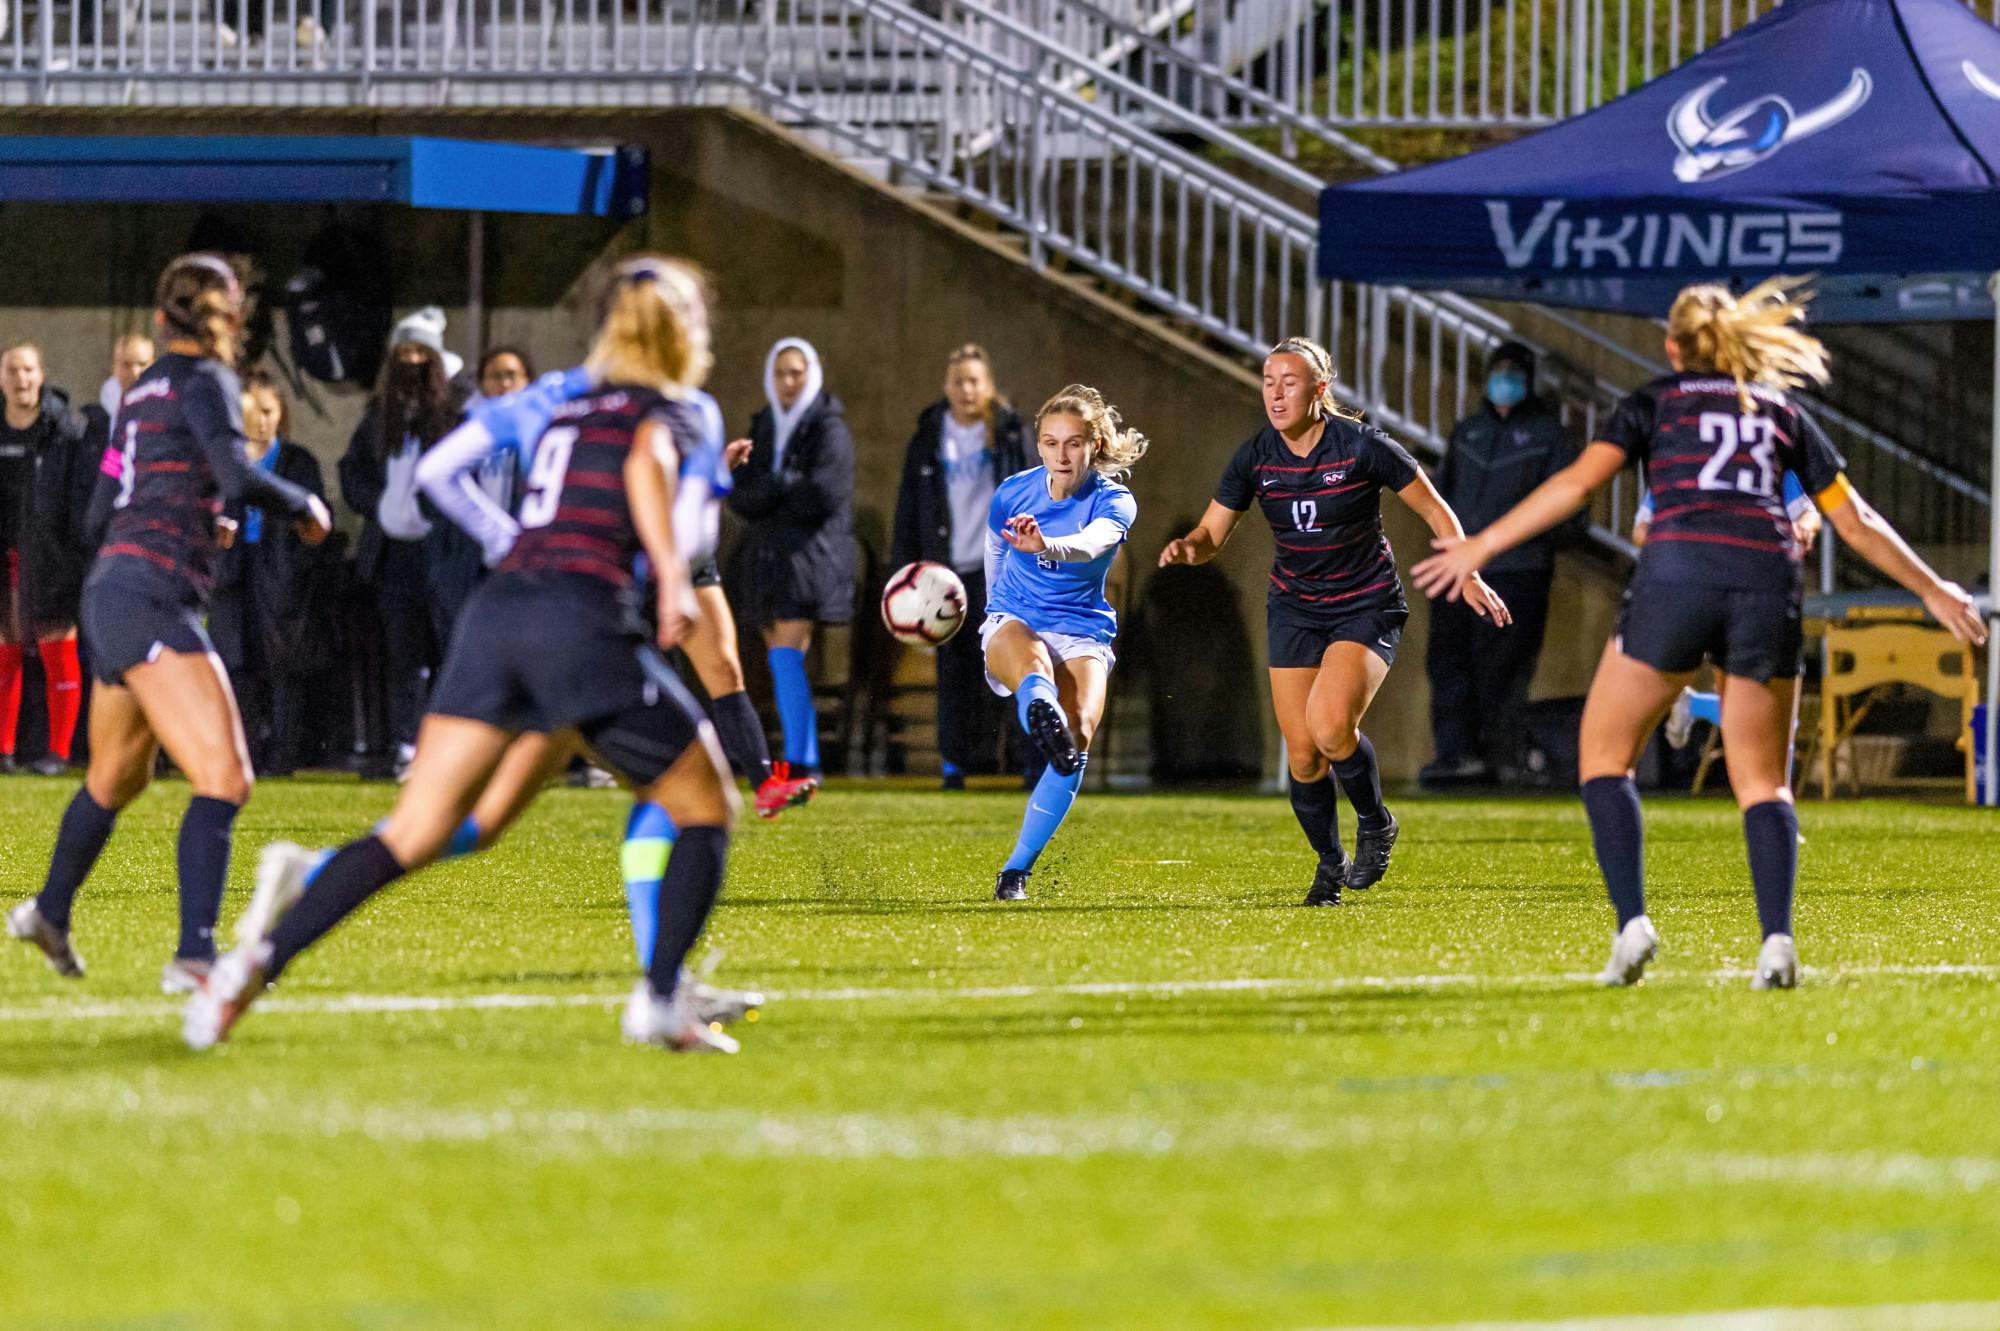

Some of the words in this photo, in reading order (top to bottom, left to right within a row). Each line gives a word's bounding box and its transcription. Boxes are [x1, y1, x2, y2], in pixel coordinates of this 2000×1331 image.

[519, 425, 580, 529] 9
[1697, 411, 1777, 497] 23
[1291, 500, 1323, 533] 12
